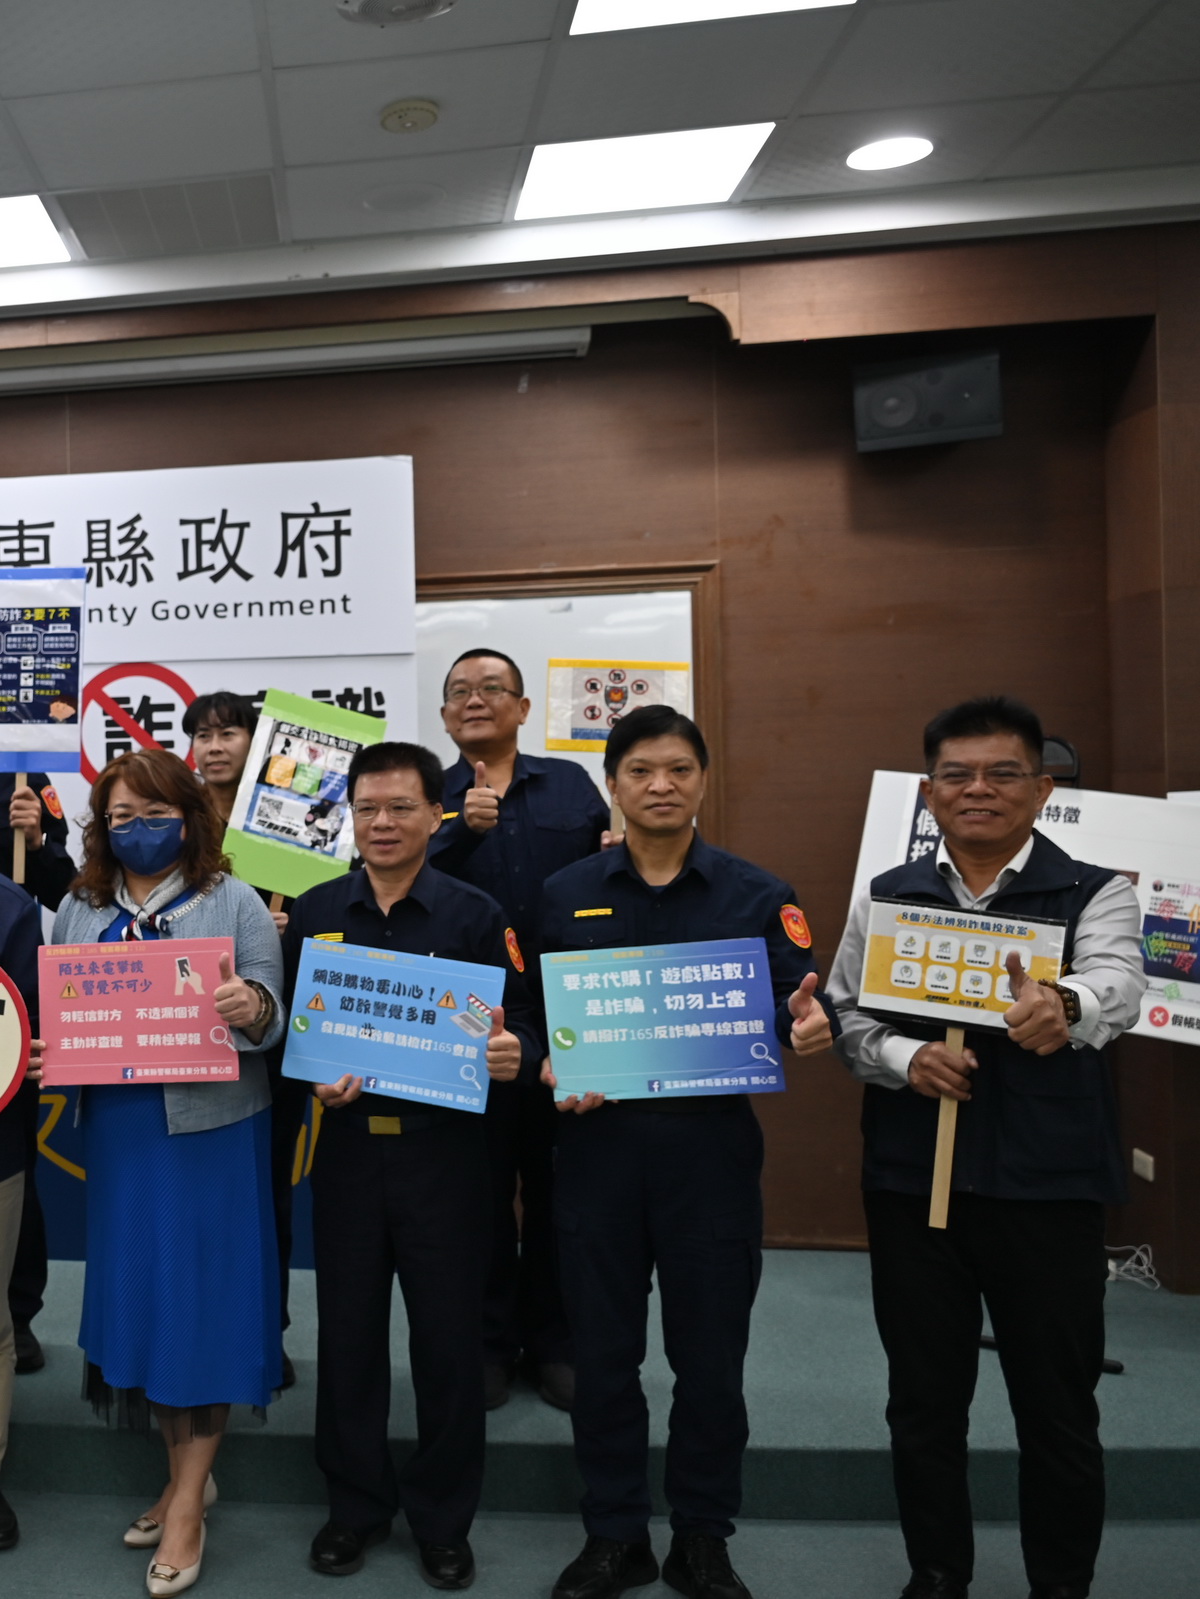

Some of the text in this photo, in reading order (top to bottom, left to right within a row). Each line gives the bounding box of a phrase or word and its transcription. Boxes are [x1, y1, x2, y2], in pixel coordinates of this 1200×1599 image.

[88, 603, 138, 627] nty
[151, 594, 352, 621] Government
[58, 960, 144, 976] 陌生來電攀談
[82, 979, 152, 996] 警覺不可少
[60, 1009, 122, 1023] 勿輕信對方
[583, 1019, 766, 1043] 請撥打165反詐騙專線查證
[60, 1035, 123, 1050] 主動詳查證
